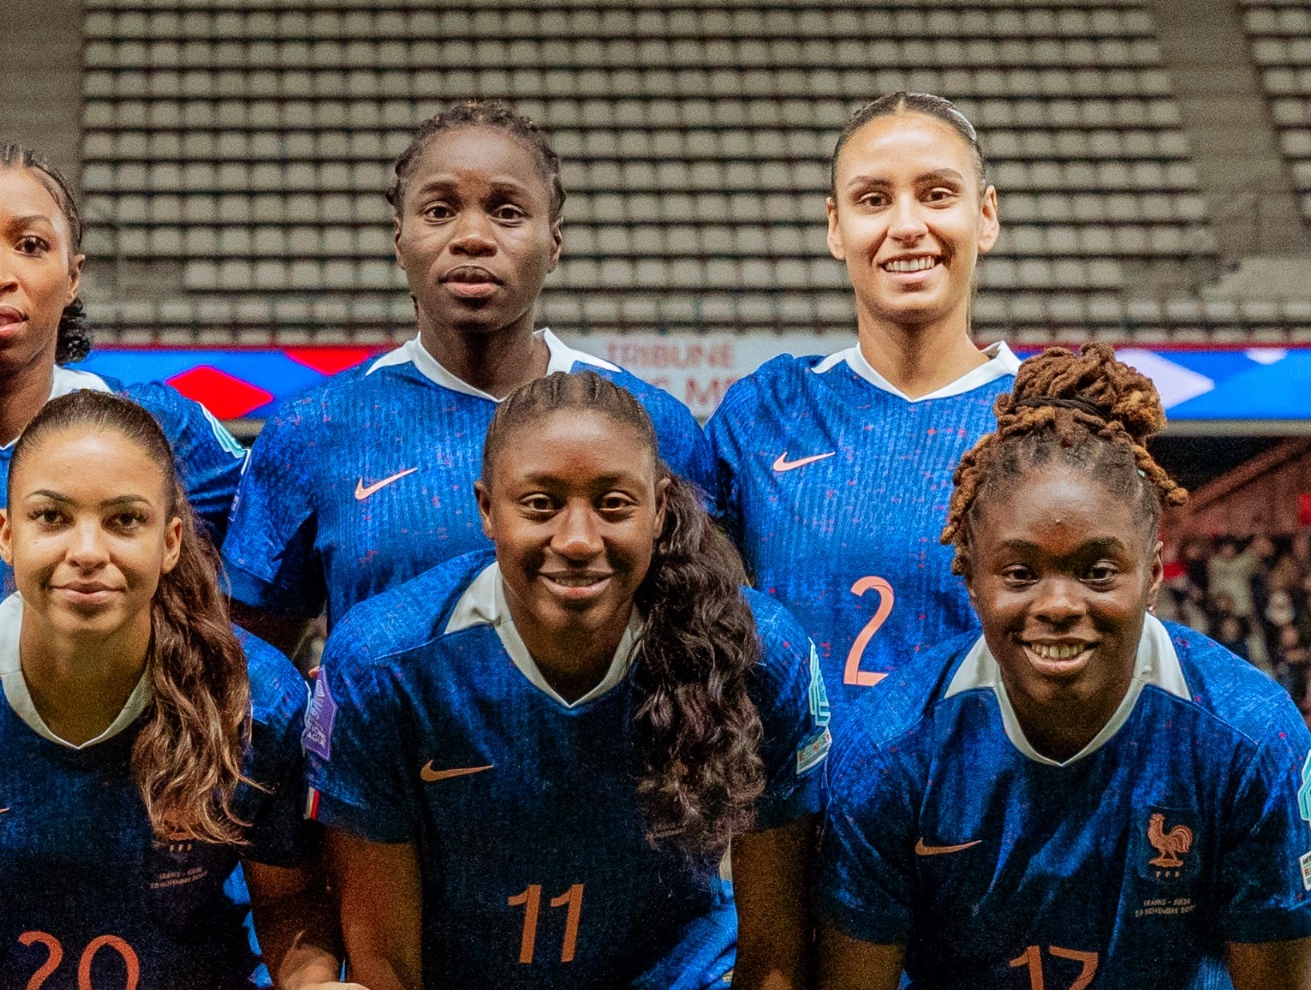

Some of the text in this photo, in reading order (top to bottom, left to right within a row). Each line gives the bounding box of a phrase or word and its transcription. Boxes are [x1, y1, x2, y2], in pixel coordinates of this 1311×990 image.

[607, 342, 733, 369] TRIBUNE
[843, 575, 895, 687] 2
[507, 884, 584, 964] 11
